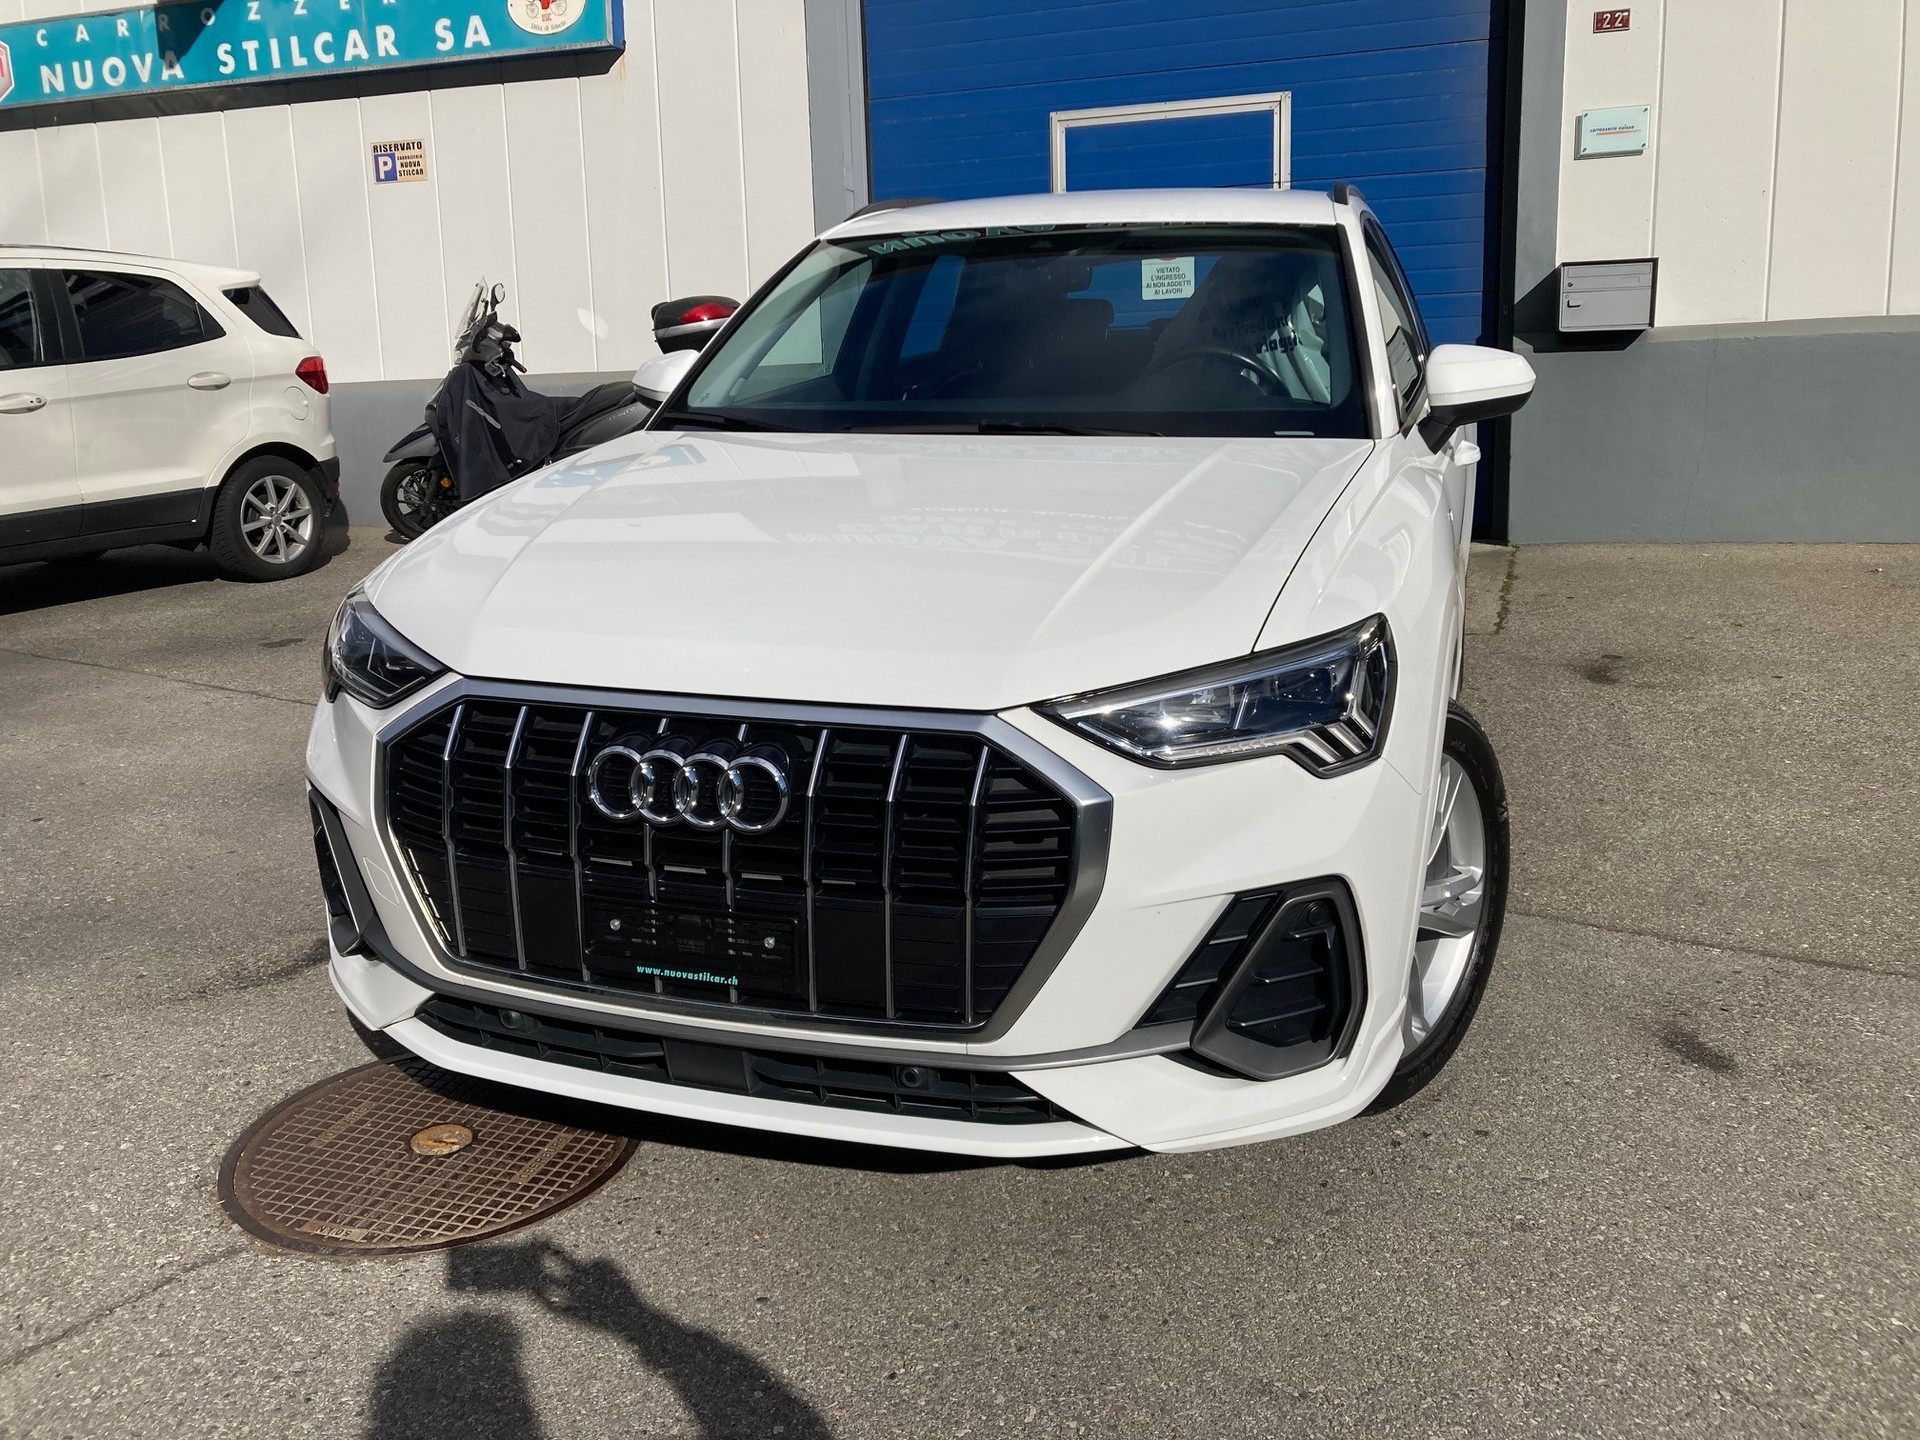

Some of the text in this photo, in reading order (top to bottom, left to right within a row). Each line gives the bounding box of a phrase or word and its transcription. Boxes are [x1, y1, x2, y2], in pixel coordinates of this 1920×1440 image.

[37, 0, 397, 47] CARROZZE
[40, 15, 491, 94] NUOVA STILCAR SA
[373, 141, 422, 154] RISERVATO
[378, 156, 393, 180] P
[400, 160, 421, 168] NUOVA
[398, 168, 424, 177] STILCAR
[1156, 266, 1180, 274] VIETATO
[1150, 273, 1186, 282] L'INGRESSO
[636, 965, 739, 986] www.nuovastilcar.ch
